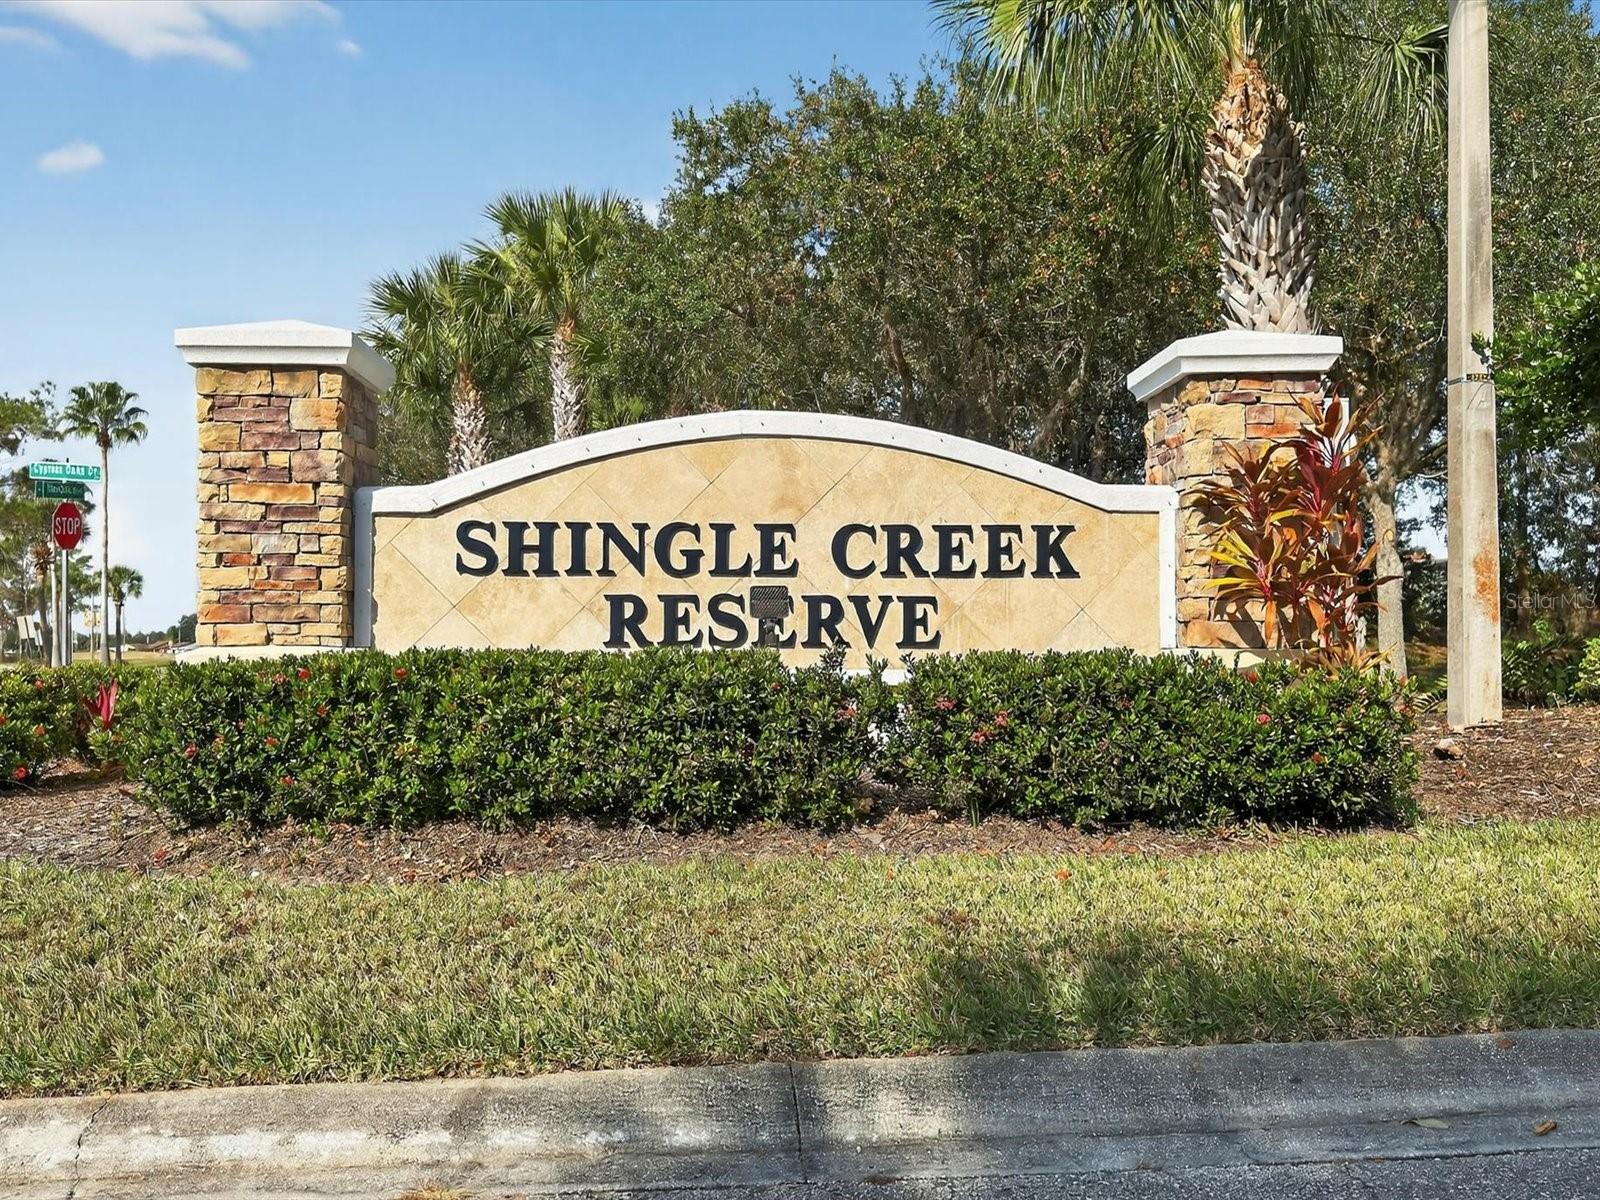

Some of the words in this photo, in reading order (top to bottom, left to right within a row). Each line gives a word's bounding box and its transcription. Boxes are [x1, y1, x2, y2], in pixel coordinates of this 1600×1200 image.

[55, 517, 80, 535] STOP
[456, 520, 799, 578] SHINGLE
[831, 523, 1081, 579] CREEK
